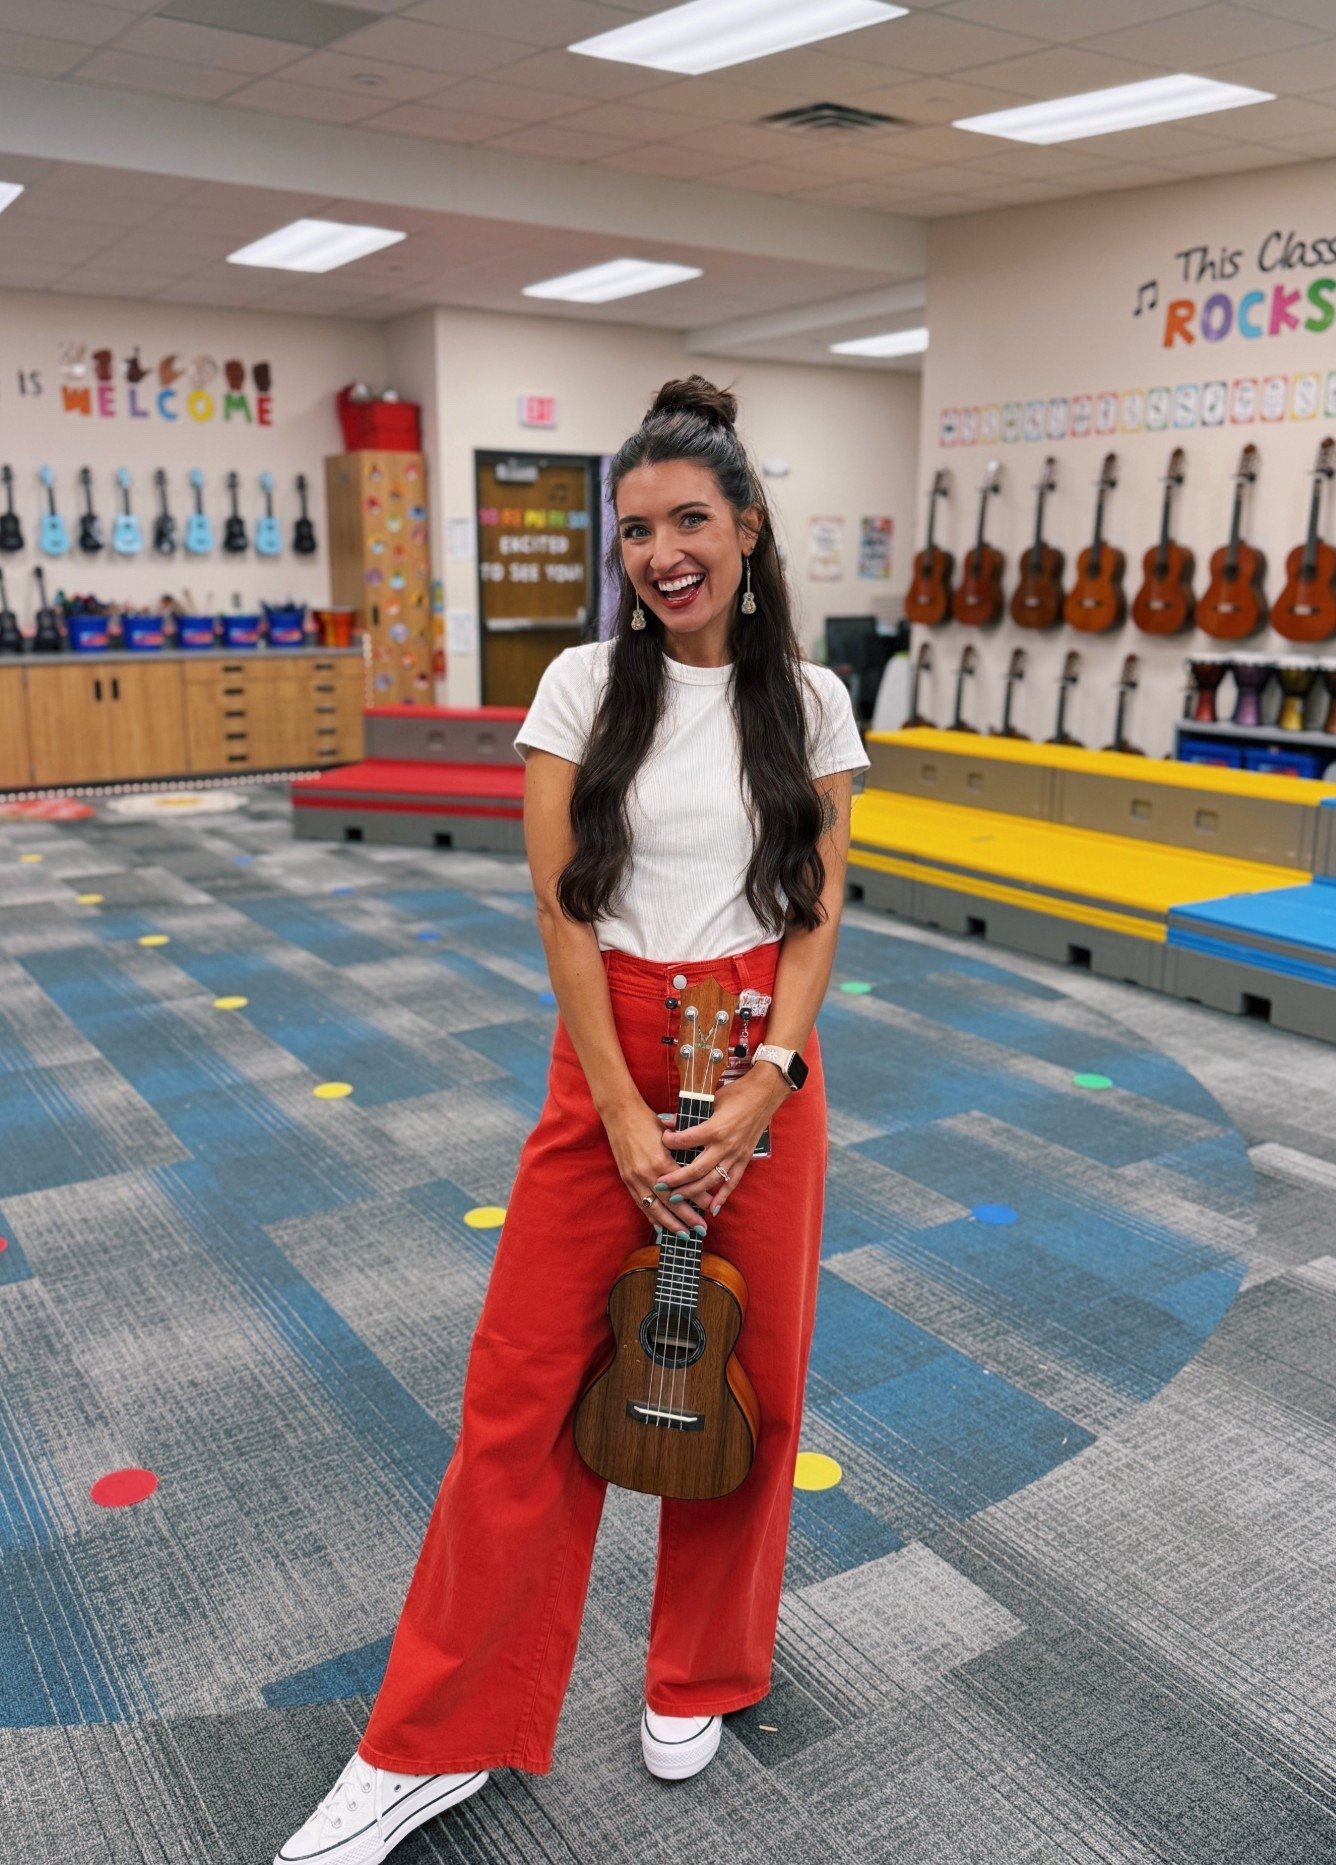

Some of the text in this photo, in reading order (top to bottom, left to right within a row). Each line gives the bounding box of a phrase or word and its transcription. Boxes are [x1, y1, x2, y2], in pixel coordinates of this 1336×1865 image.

[1175, 244, 1244, 283] This
[1161, 277, 1336, 349] ROCKS
[60, 383, 273, 426] WELCOME
[499, 534, 570, 556] EXCITED
[480, 562, 505, 583] TO
[508, 562, 540, 583] SEE
